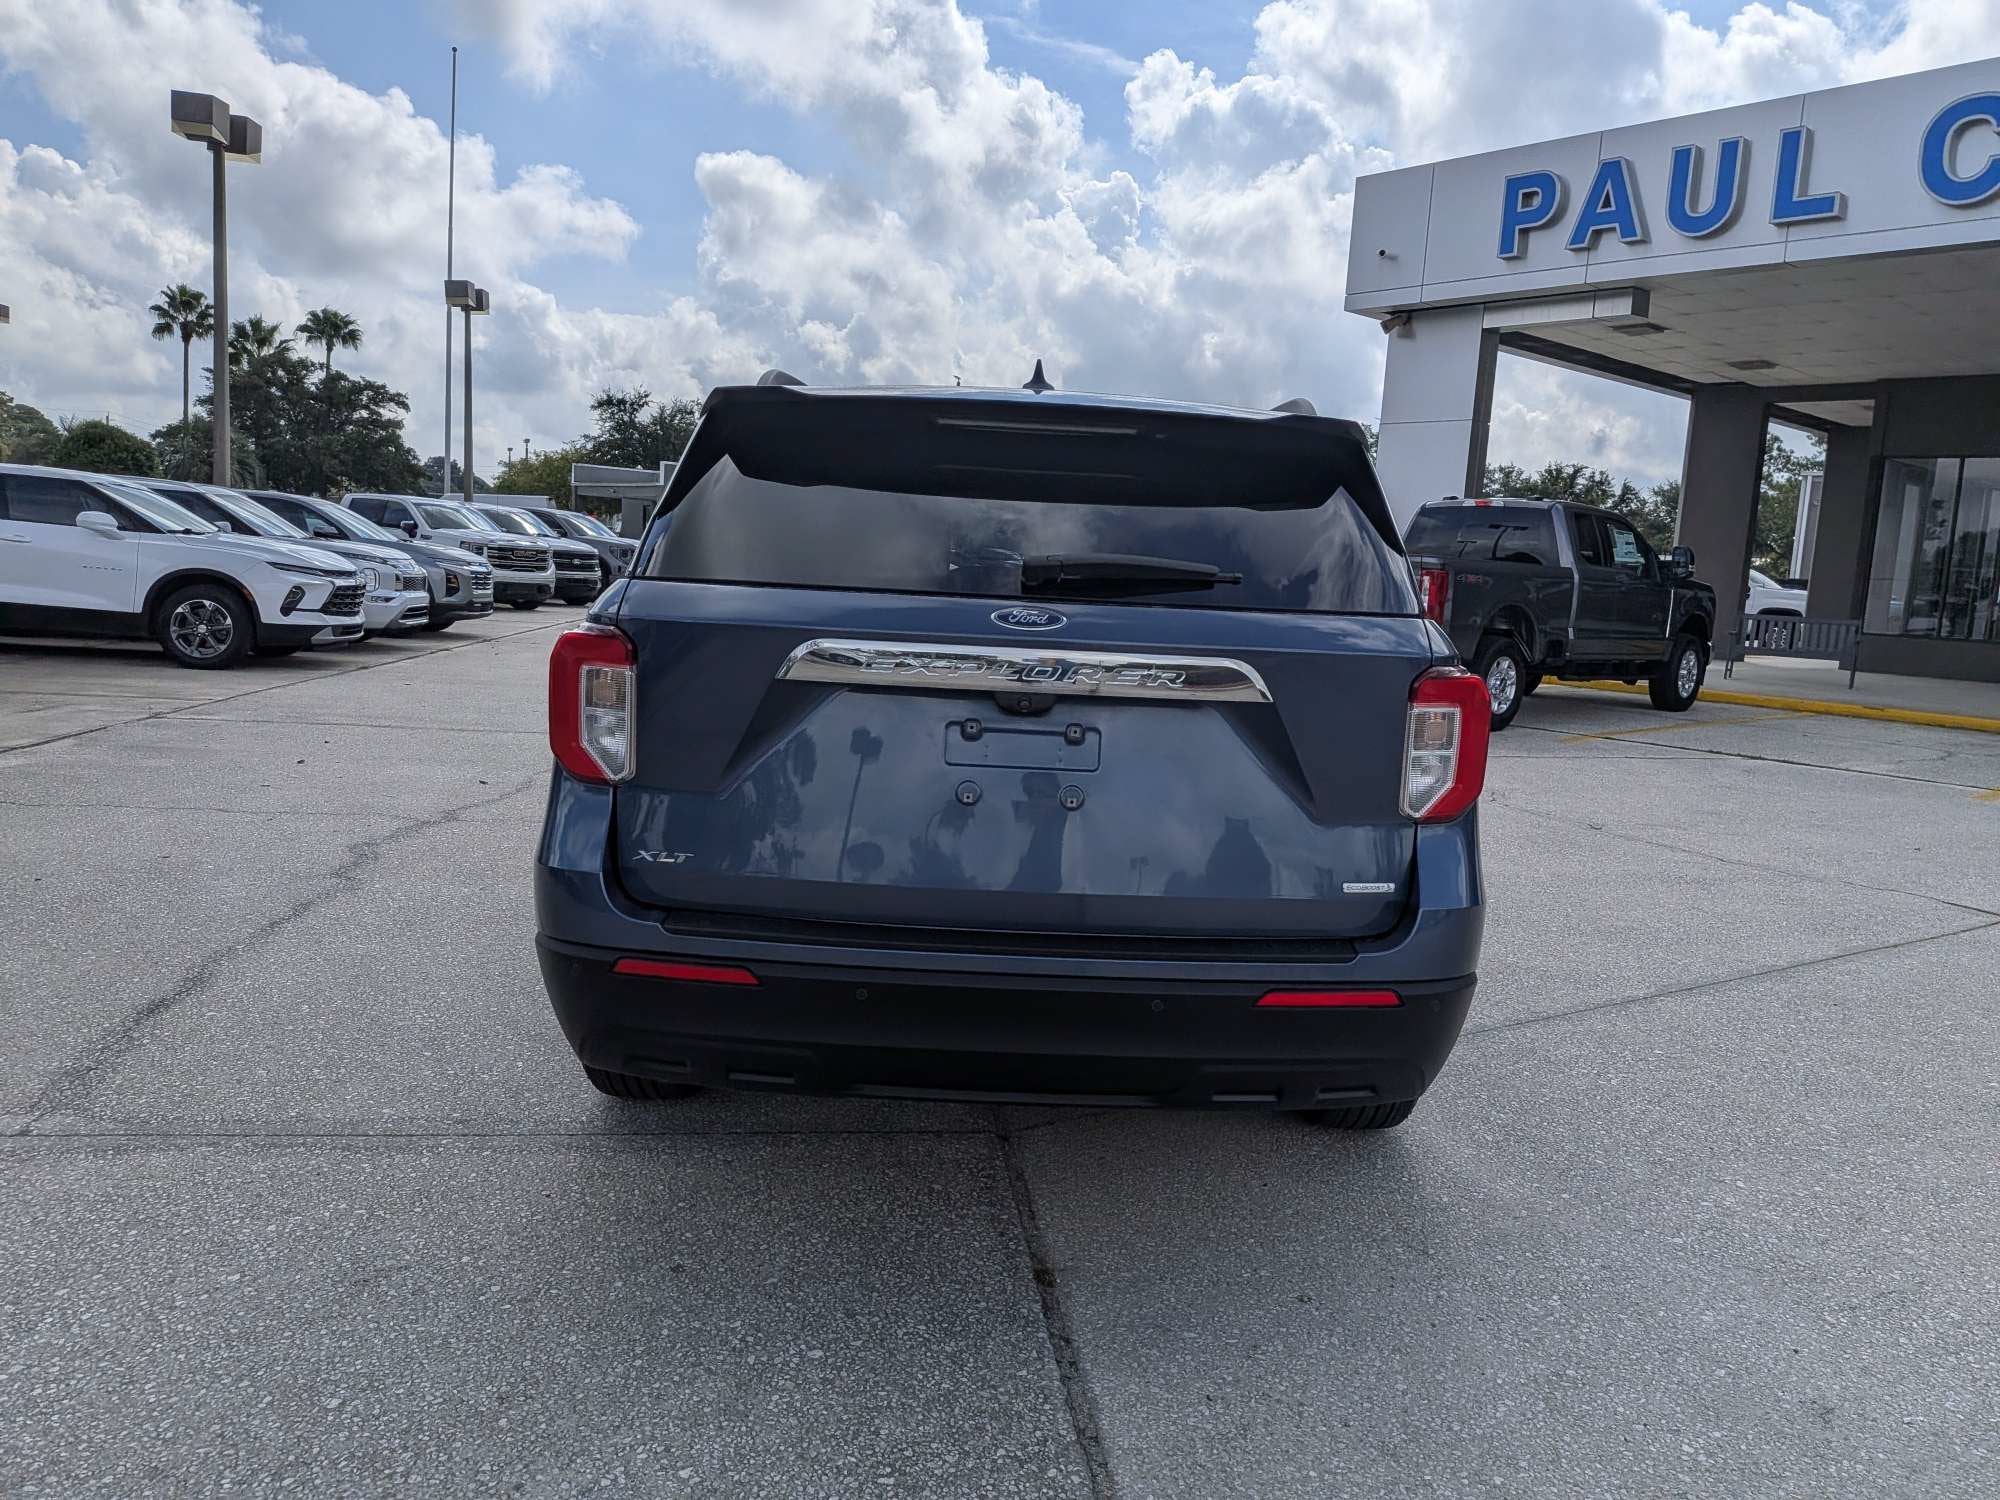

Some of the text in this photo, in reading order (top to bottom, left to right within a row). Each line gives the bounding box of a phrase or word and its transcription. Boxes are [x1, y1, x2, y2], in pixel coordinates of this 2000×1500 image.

[1497, 91, 2000, 260] PAUL C
[1009, 608, 1049, 624] Ford
[859, 657, 1186, 687] EXPLORER
[632, 850, 695, 863] XLT
